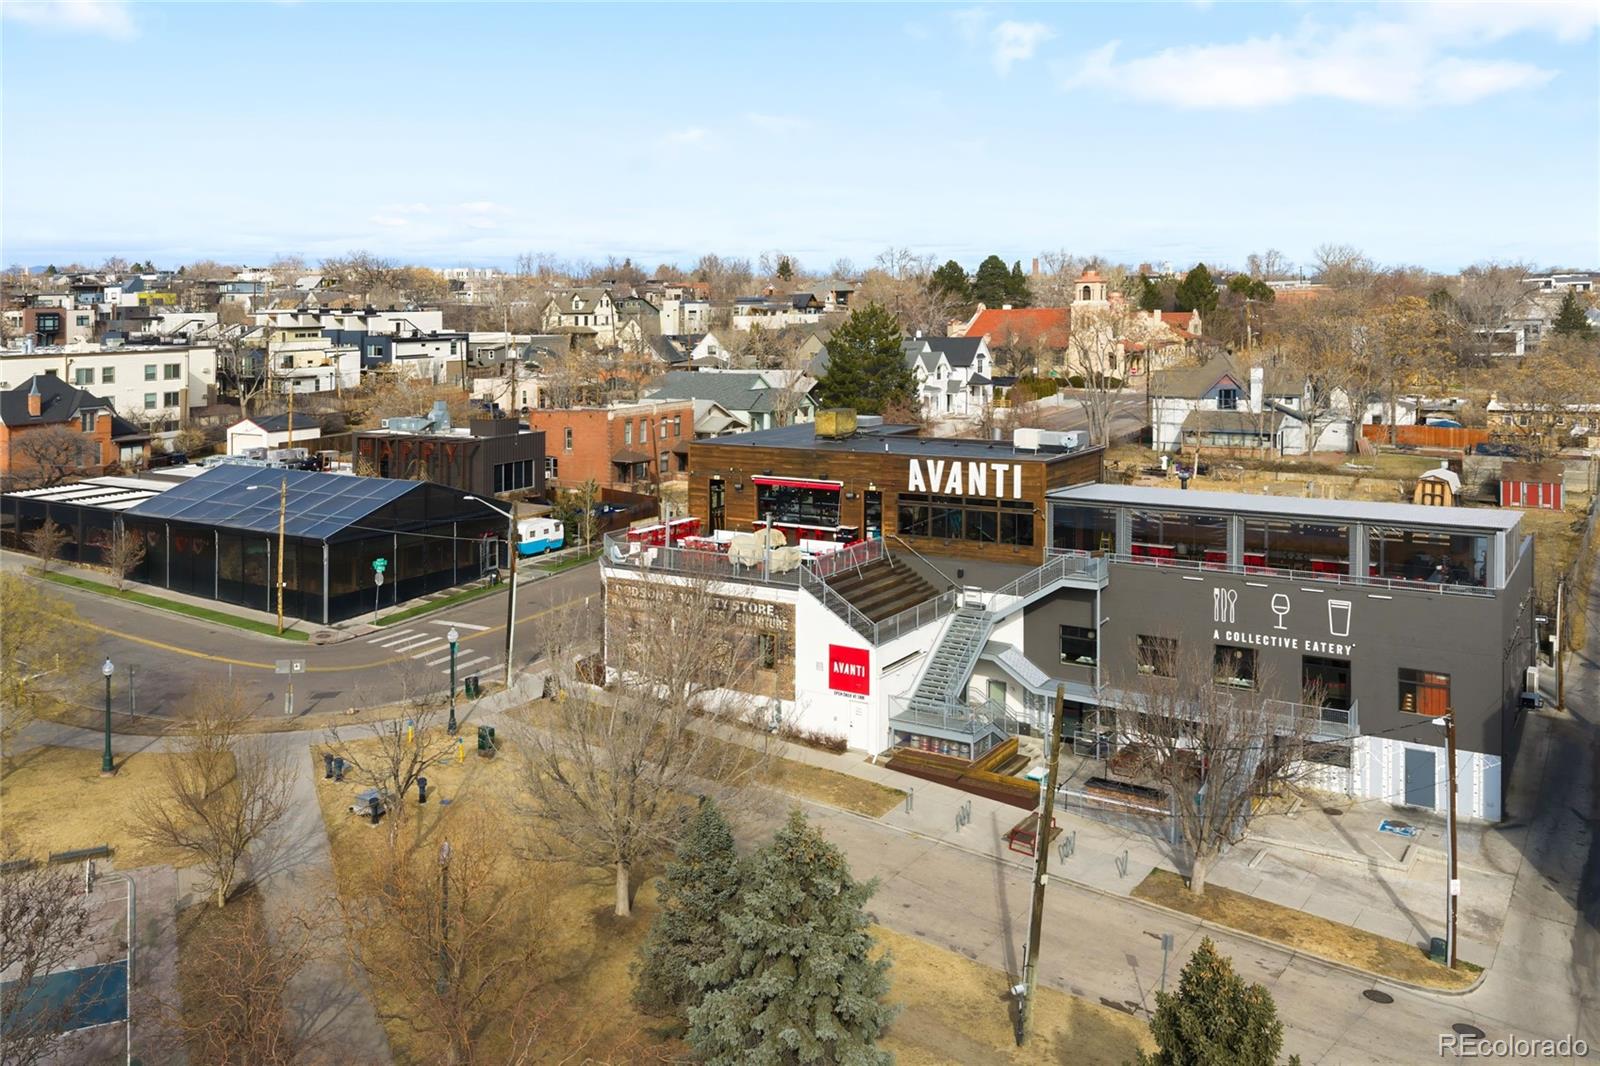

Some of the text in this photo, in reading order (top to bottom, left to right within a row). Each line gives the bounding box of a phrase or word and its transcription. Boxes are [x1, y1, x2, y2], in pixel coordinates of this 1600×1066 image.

[359, 438, 457, 465] HAPPY
[908, 459, 1022, 499] AVANTI
[1213, 629, 1353, 656] A COLLECTIVE EATERY
[833, 661, 865, 677] AVANTI
